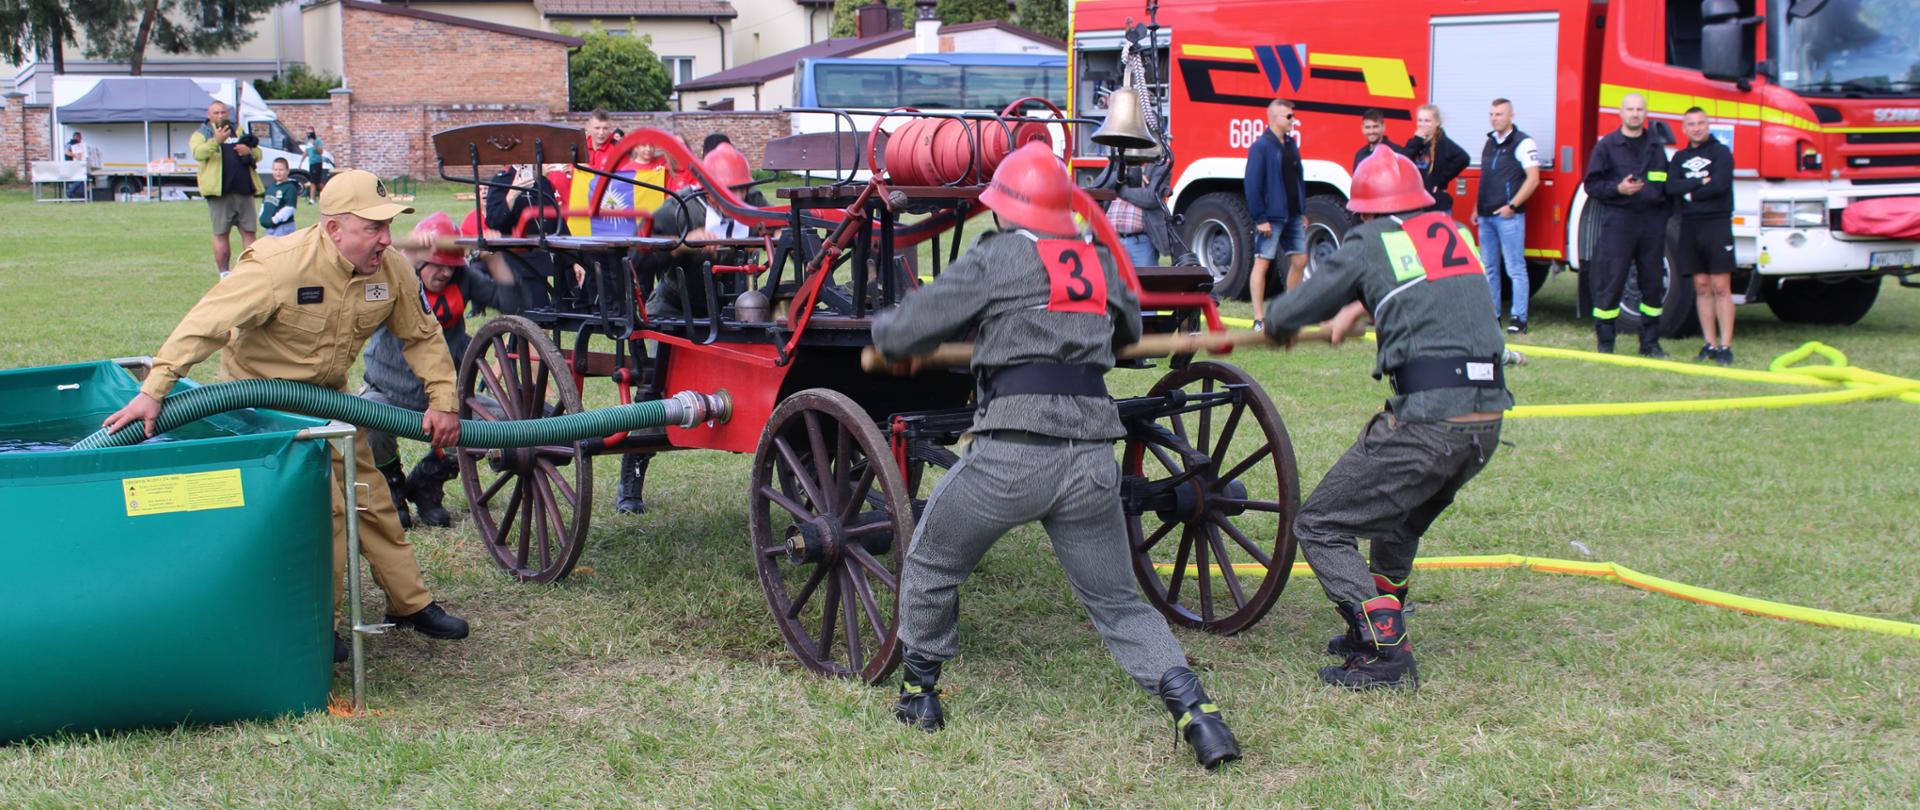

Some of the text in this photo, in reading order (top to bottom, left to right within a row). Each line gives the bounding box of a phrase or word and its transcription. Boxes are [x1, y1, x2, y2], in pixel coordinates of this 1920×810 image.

[1230, 118, 1301, 148] 6886
[1426, 222, 1469, 268] 2
[1059, 249, 1093, 302] 3
